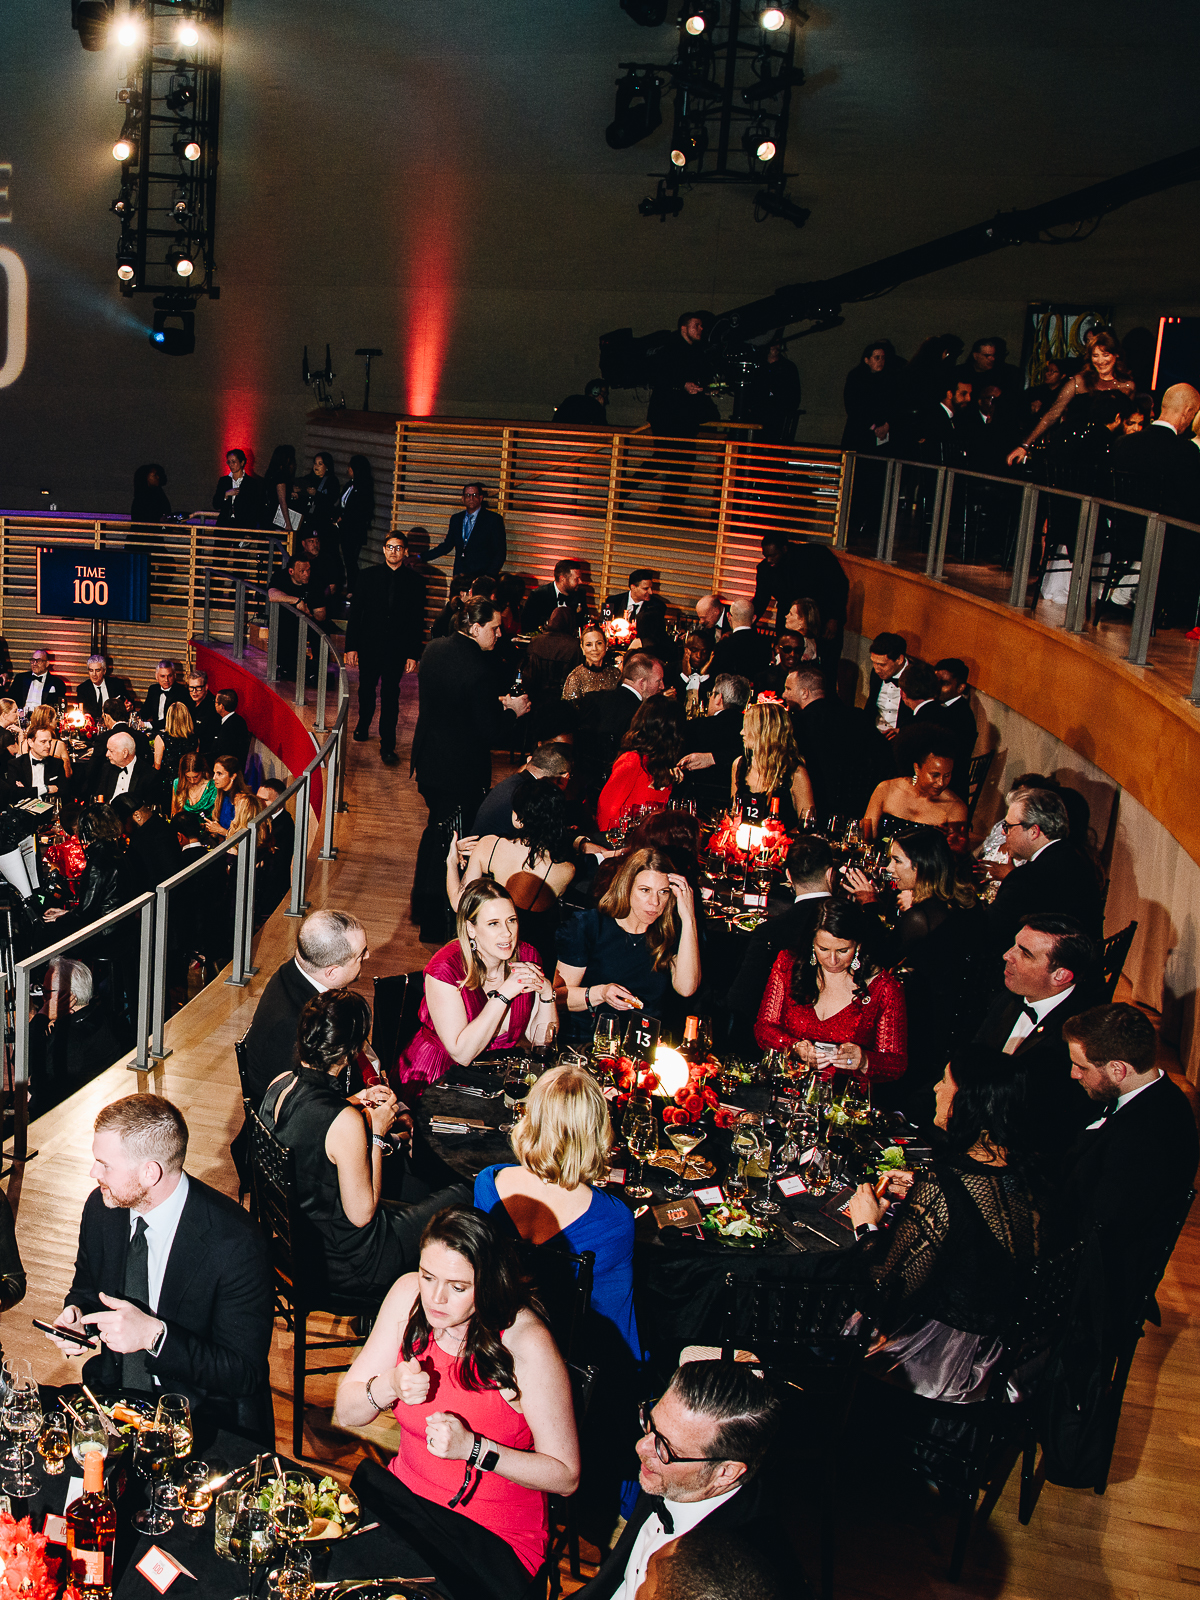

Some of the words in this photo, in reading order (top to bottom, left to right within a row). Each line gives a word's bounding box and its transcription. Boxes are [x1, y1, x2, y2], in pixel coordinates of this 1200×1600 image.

[75, 565, 106, 578] TIME
[73, 579, 108, 605] 100
[746, 806, 758, 818] 12
[636, 1030, 651, 1047] 13
[667, 1210, 688, 1220] 100
